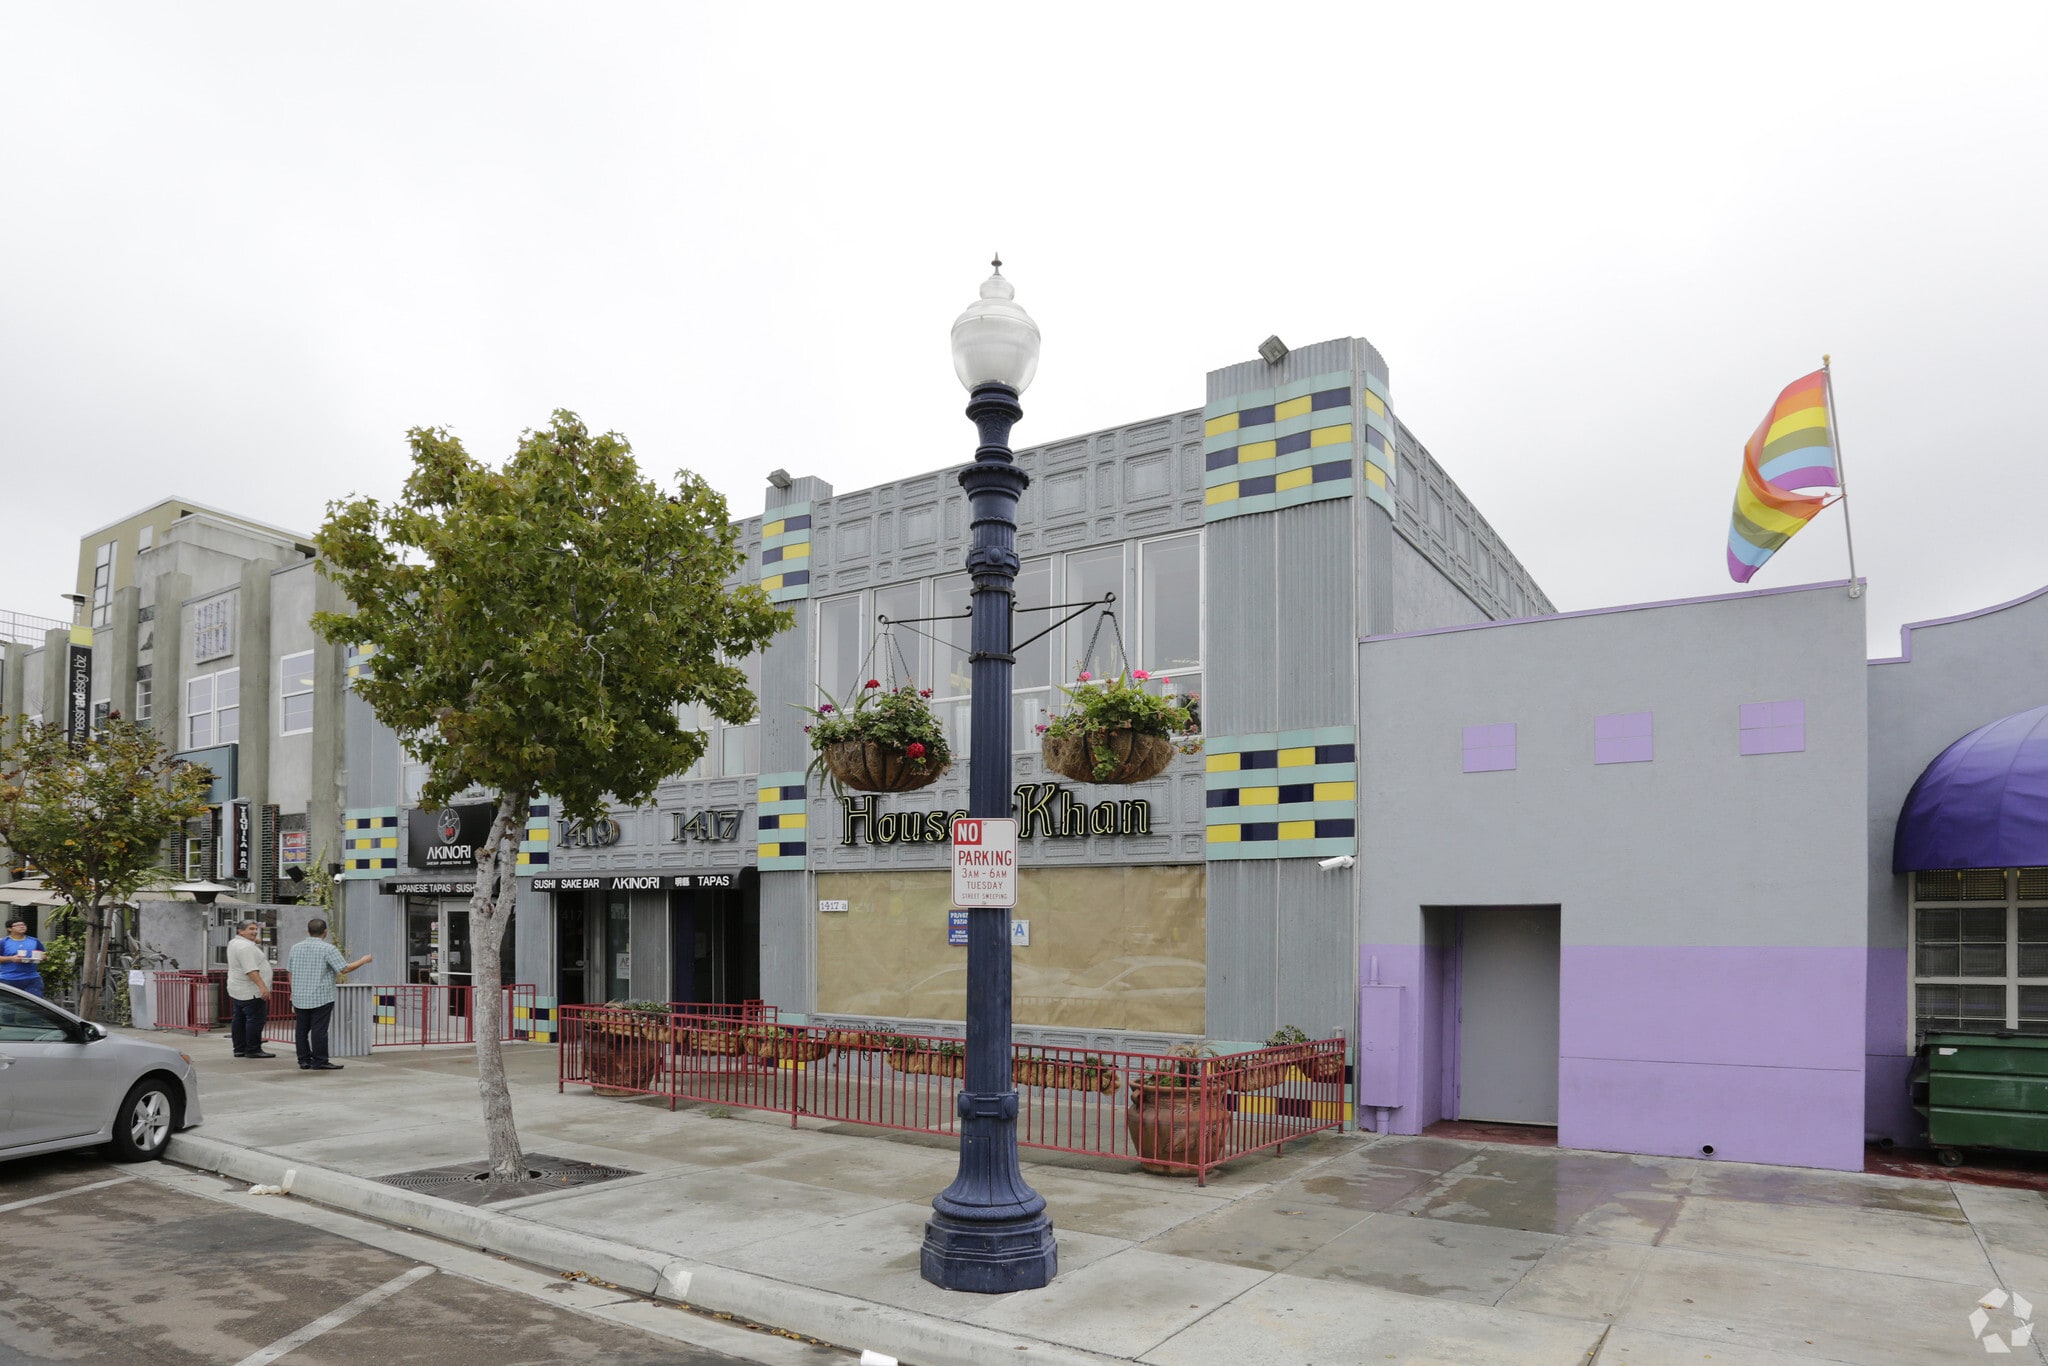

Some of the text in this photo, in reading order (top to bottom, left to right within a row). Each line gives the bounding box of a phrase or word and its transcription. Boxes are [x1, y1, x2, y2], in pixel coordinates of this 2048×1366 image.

[841, 783, 1152, 845] Hous Khan
[556, 818, 621, 848] 1419
[671, 810, 744, 842] 1417
[957, 822, 979, 842] NO
[239, 806, 248, 869] TEQUILA BAR
[426, 845, 471, 860] AKINORI
[958, 850, 1012, 866] PARKING
[962, 868, 979, 878] 3AM
[989, 868, 1007, 878] 6AM
[395, 884, 428, 893] JAPANESE
[429, 884, 451, 893] TAPAS
[534, 880, 556, 889] SUSHI
[561, 879, 582, 889] SAKE
[583, 879, 600, 888] BAR
[612, 877, 660, 890] AKINORI
[697, 876, 730, 886] TAPAS
[967, 881, 1003, 889] TUESDAY
[821, 901, 839, 910] 1417
[1015, 923, 1025, 936] A
